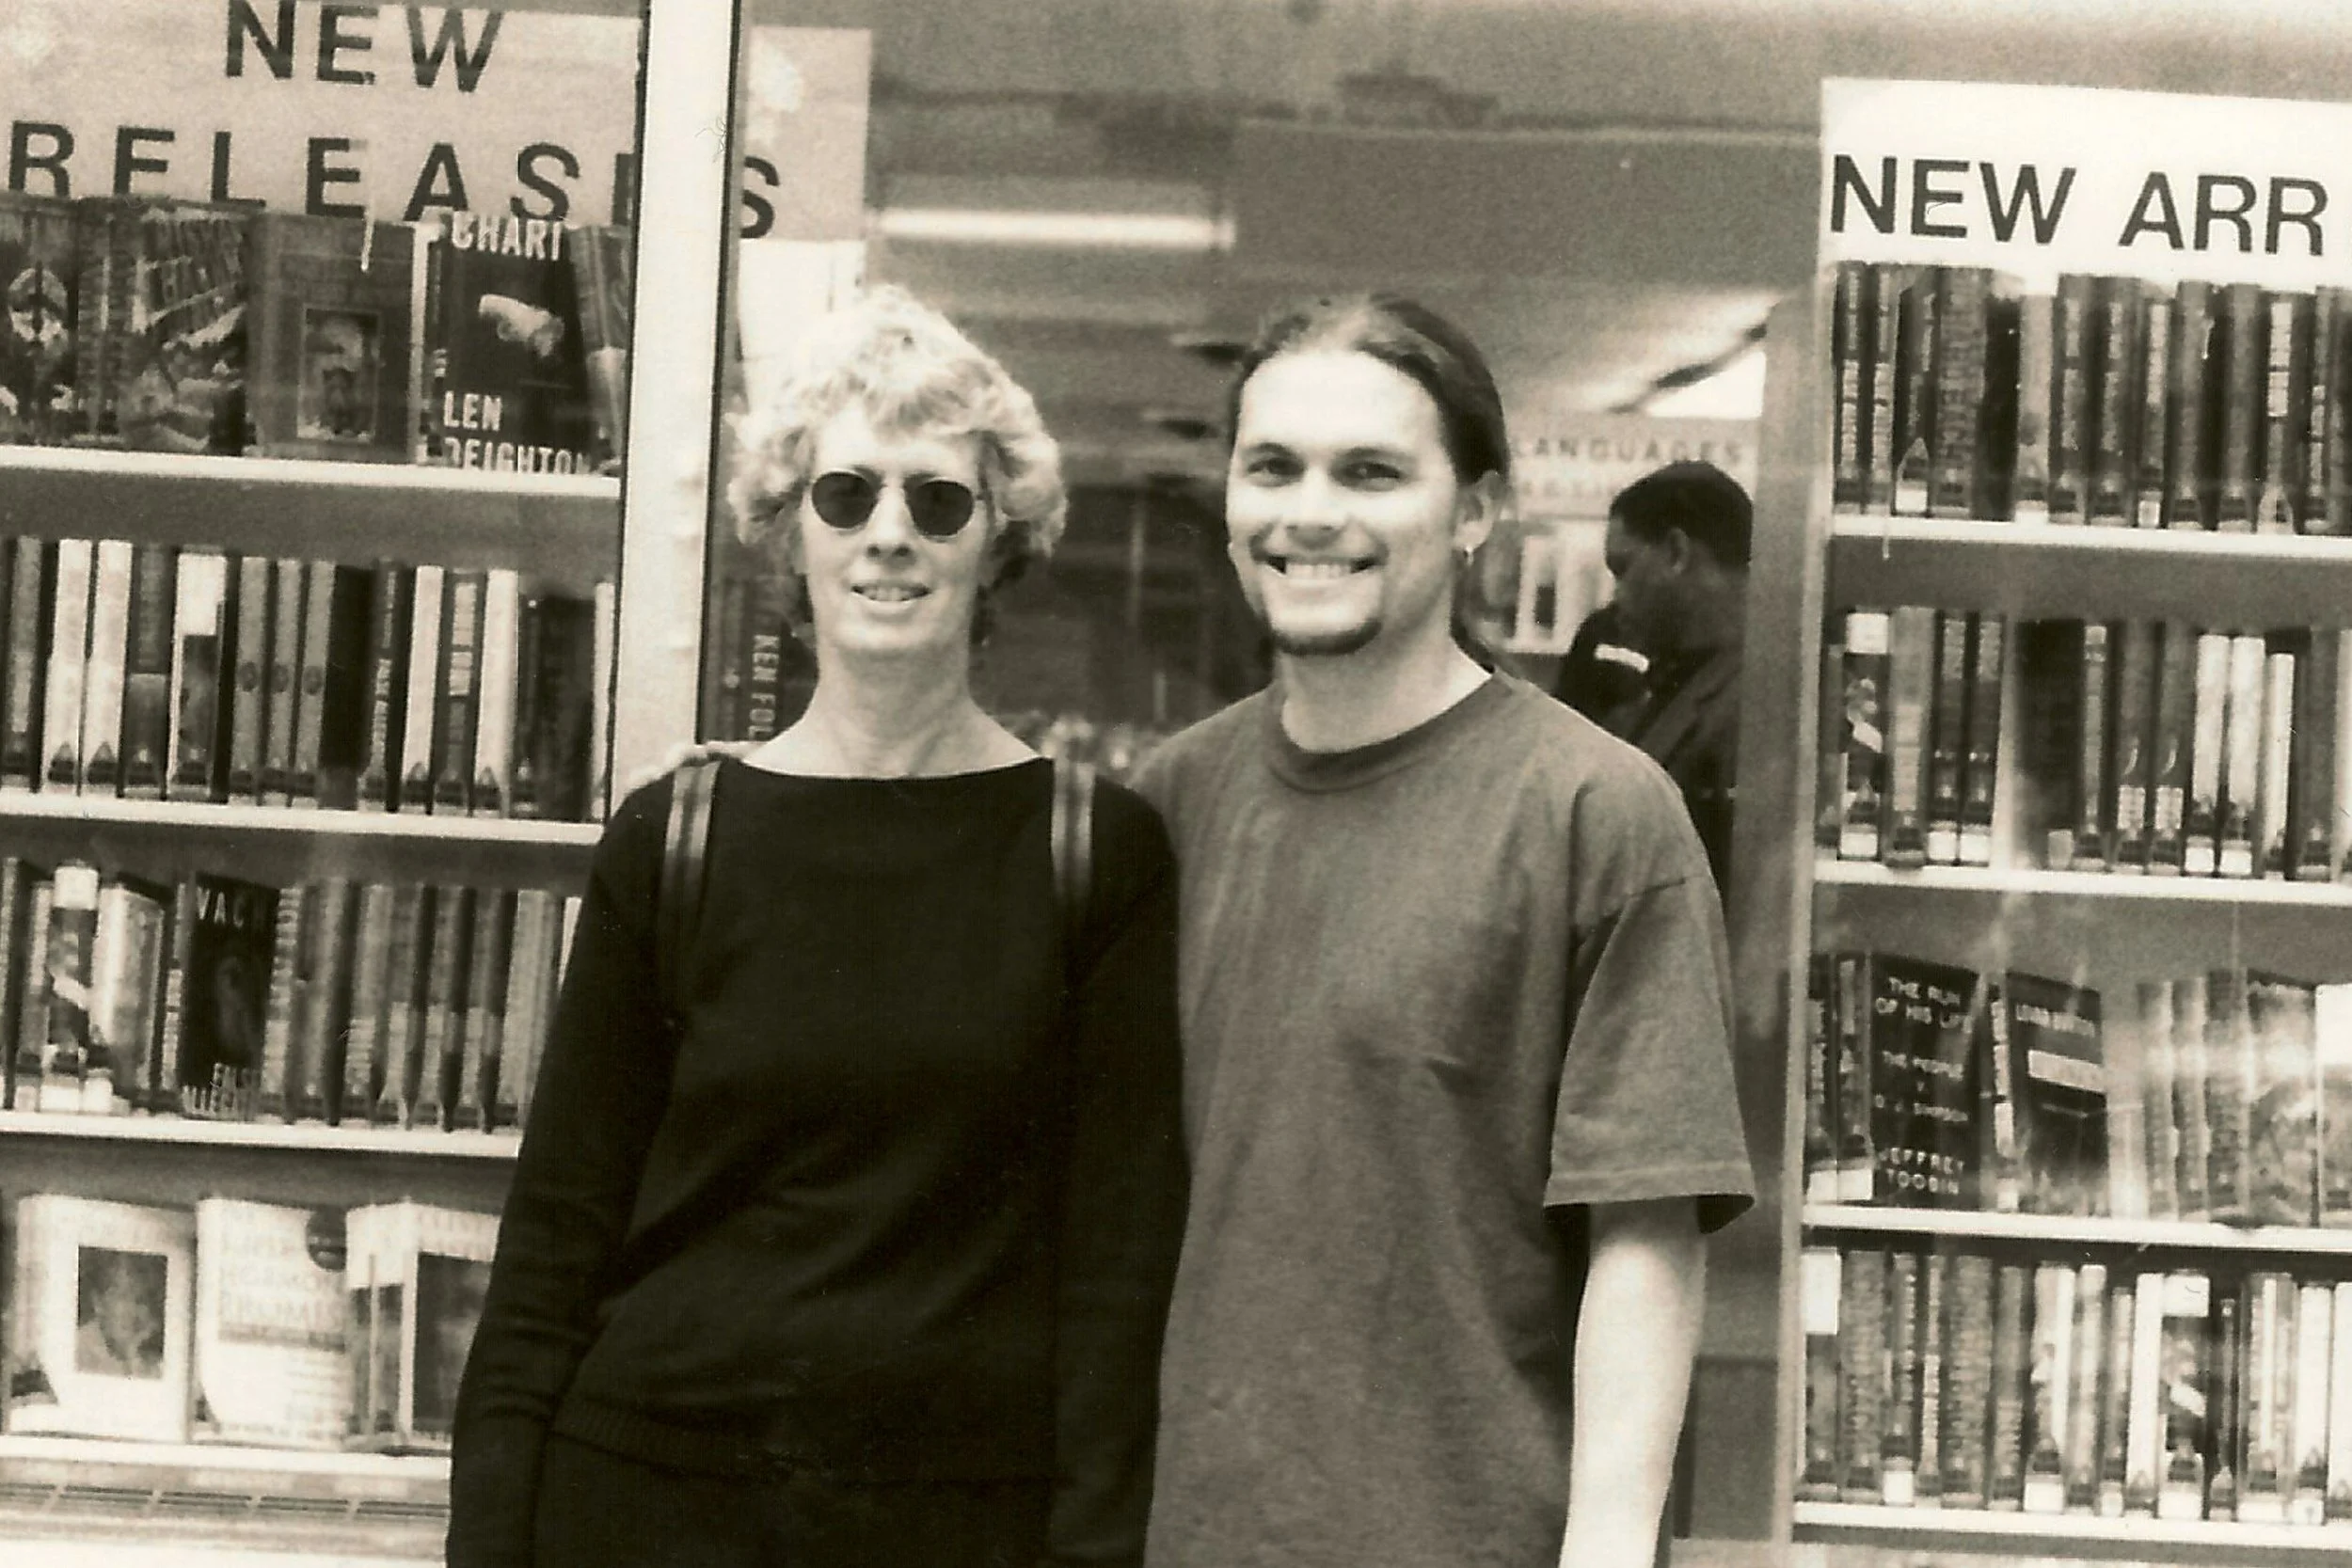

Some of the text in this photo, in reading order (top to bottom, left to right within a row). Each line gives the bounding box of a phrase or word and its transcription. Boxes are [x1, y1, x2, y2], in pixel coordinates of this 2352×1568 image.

[225, 0, 502, 92] NEW
[1830, 154, 2328, 256] NEW ARR
[443, 390, 502, 432] LEN
[754, 634, 780, 681] KEN
